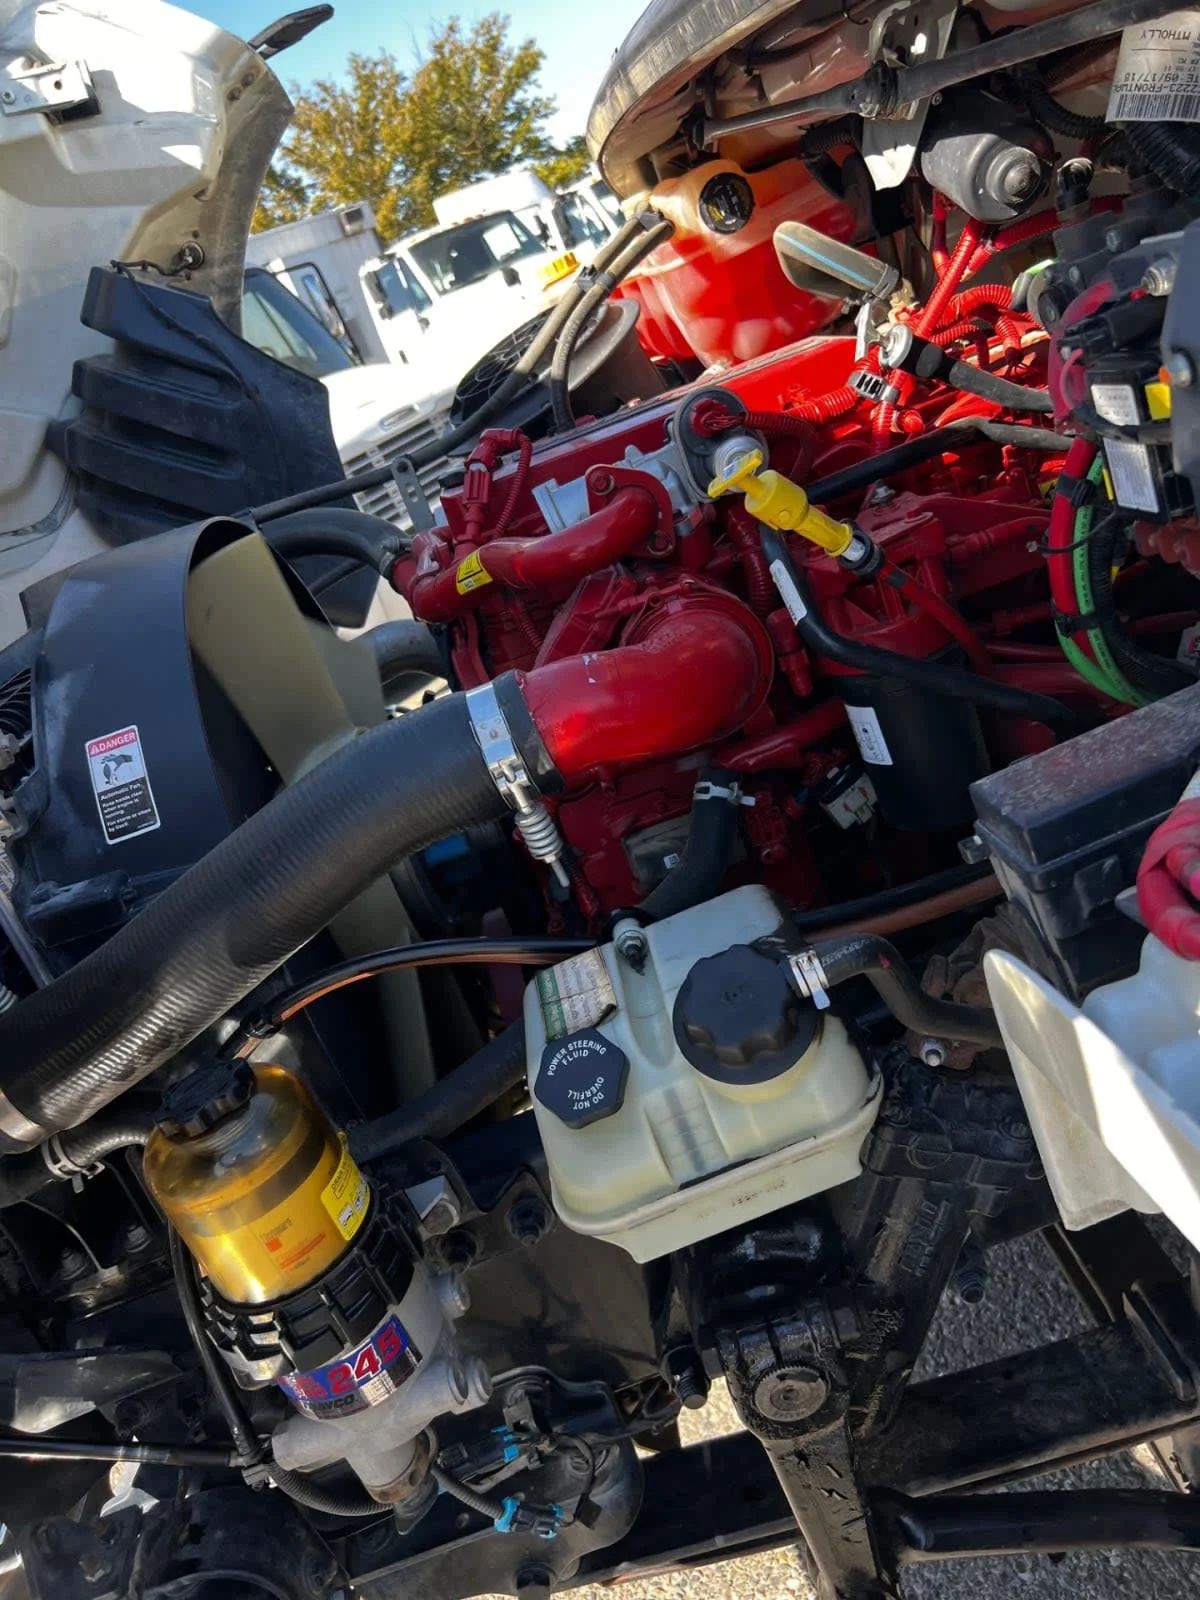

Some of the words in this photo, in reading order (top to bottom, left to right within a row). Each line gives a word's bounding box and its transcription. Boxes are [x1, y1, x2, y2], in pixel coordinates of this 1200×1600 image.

[1141, 29, 1191, 40] MTHOLLY
[100, 732, 136, 751] DANGER
[547, 1048, 567, 1076] POWER
[567, 1039, 607, 1055] STEERING
[561, 1049, 589, 1066] FLUID
[567, 1076, 605, 1100] OVERFILL
[573, 1100, 590, 1110] NOT
[592, 1091, 605, 1104] DO
[326, 1321, 403, 1394] 245
